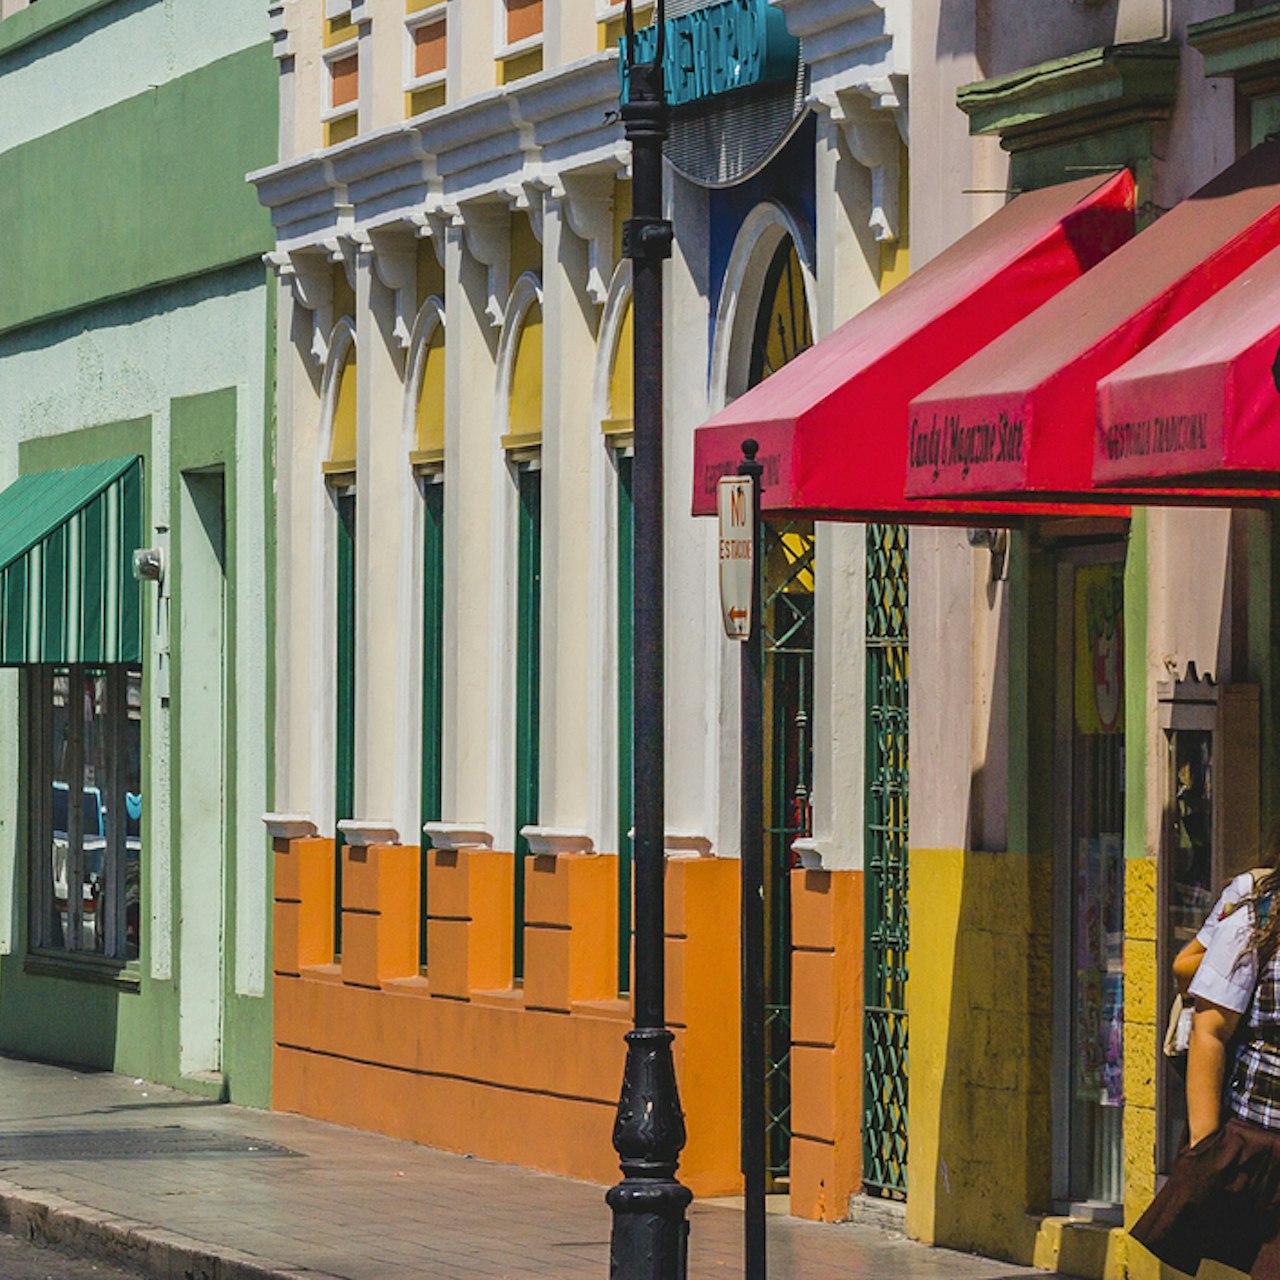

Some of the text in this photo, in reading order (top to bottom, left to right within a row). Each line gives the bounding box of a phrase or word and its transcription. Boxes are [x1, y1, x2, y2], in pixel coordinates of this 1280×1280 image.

[910, 413, 941, 483] Candy
[949, 413, 997, 481] Magazine
[997, 411, 1024, 464] Store
[730, 486, 748, 528] NO
